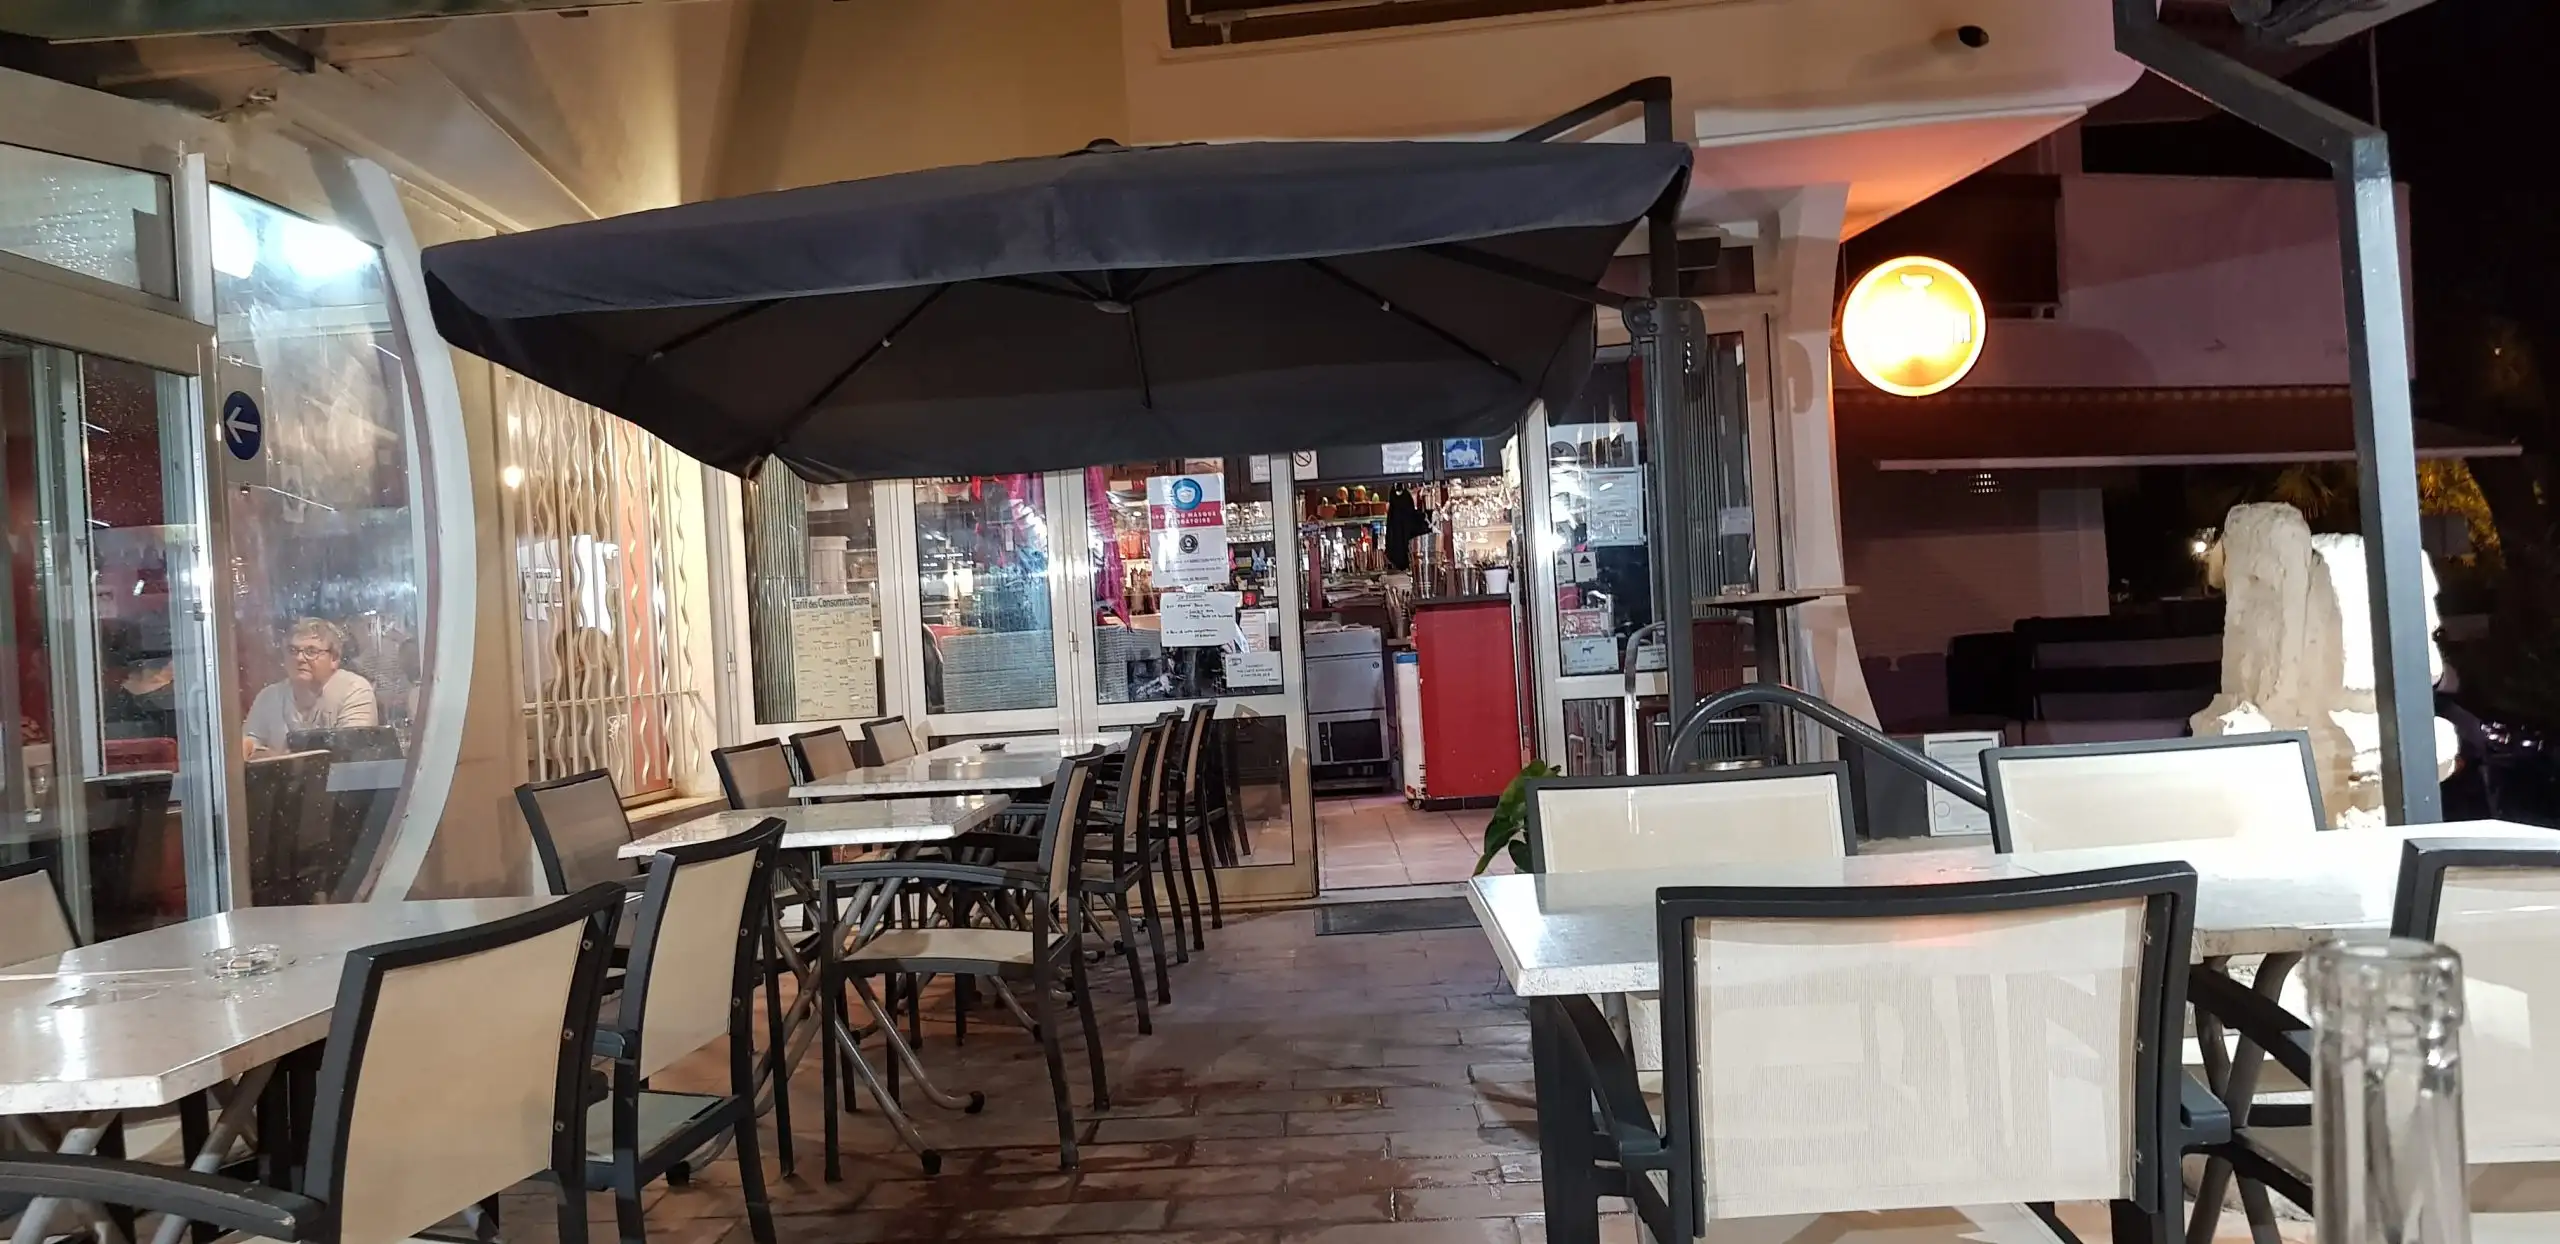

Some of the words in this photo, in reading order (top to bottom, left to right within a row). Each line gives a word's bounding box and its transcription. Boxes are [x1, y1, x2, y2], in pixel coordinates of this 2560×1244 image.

[791, 598, 808, 610] Tarif
[808, 601, 818, 609] des
[818, 595, 870, 609] Consommations
